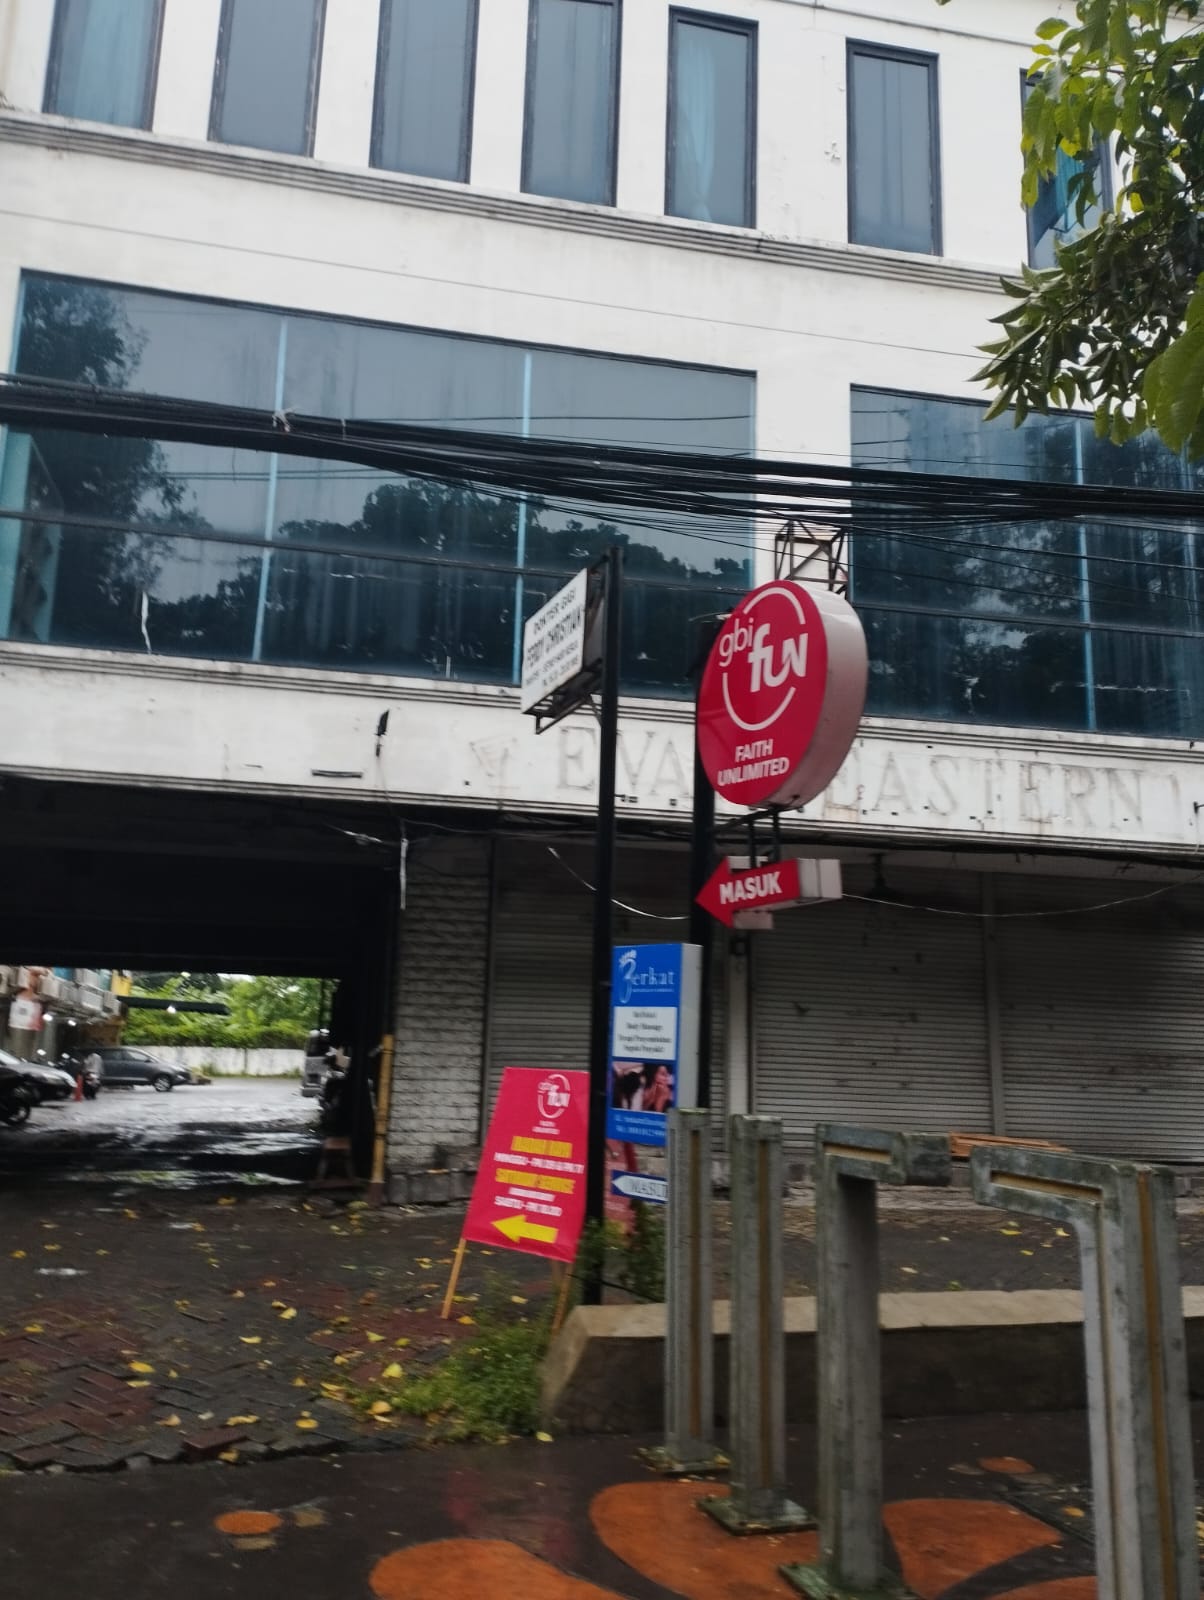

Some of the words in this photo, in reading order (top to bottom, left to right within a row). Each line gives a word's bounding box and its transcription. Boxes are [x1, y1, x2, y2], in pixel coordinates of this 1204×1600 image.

[718, 617, 754, 667] gbi
[734, 738, 775, 763] FAITH
[716, 756, 790, 787] UNLIMITED
[719, 871, 783, 905] MASUK
[631, 1178, 669, 1199] MASU
